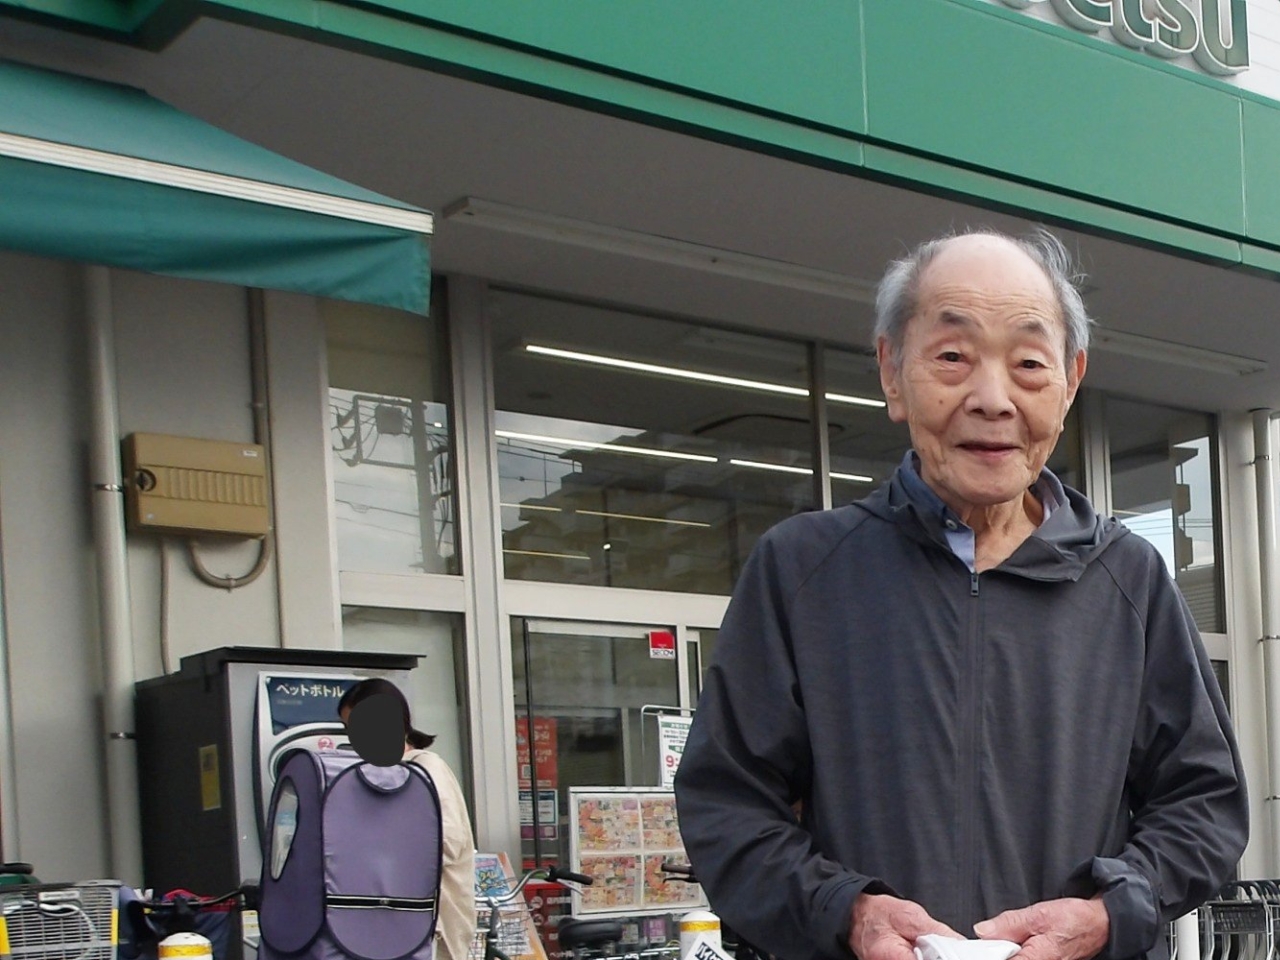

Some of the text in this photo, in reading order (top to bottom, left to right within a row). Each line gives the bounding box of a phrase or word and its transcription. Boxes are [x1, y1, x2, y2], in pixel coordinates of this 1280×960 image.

[276, 684, 345, 698] ペットボトル
